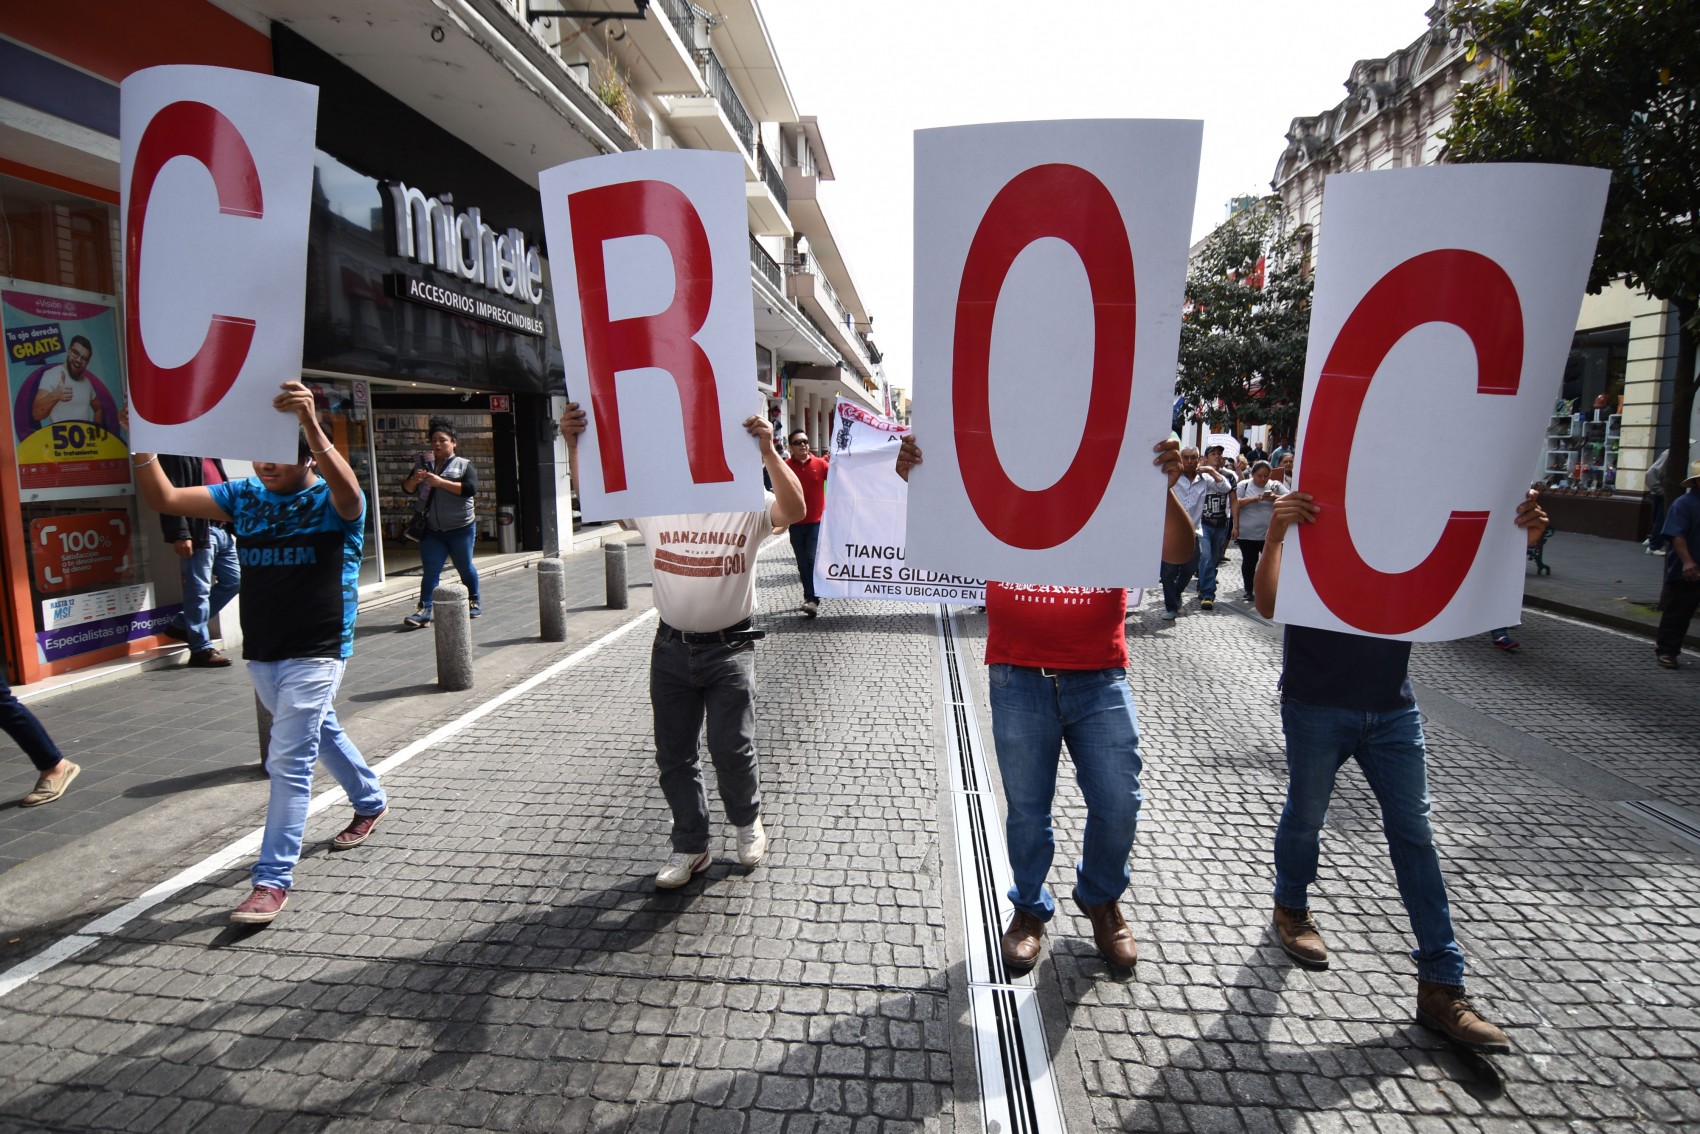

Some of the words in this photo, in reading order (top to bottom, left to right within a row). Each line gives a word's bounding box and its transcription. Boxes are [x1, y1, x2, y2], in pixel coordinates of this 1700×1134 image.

[386, 180, 543, 304] michelle
[410, 279, 475, 314] ACCESORIOS
[476, 303, 543, 335] IMPRESCINDIBLES
[7, 332, 16, 341] Tu
[17, 330, 29, 341] ojo
[31, 326, 59, 338] derecho
[13, 337, 61, 358] GRATIS
[127, 101, 262, 424] C
[568, 180, 734, 492] R
[953, 164, 1136, 550] O
[1298, 249, 1524, 634] C
[63, 449, 98, 457] tratamientos
[59, 530, 111, 552] 100%
[659, 530, 747, 548] MANZANILLO
[61, 551, 98, 561] Satisfacción
[240, 547, 317, 567] ROBLEM
[845, 544, 905, 560] TIANGU
[71, 564, 92, 574] dinero
[828, 563, 893, 580] CALLES
[864, 583, 902, 595] ANTES
[905, 586, 958, 599] UBICADO
[961, 589, 977, 600] EN
[1014, 594, 1055, 604] BROKEN
[1064, 597, 1091, 605] HOPE
[45, 627, 114, 650] Especialistas
[116, 624, 129, 634] en
[131, 613, 177, 631] Progresiv
